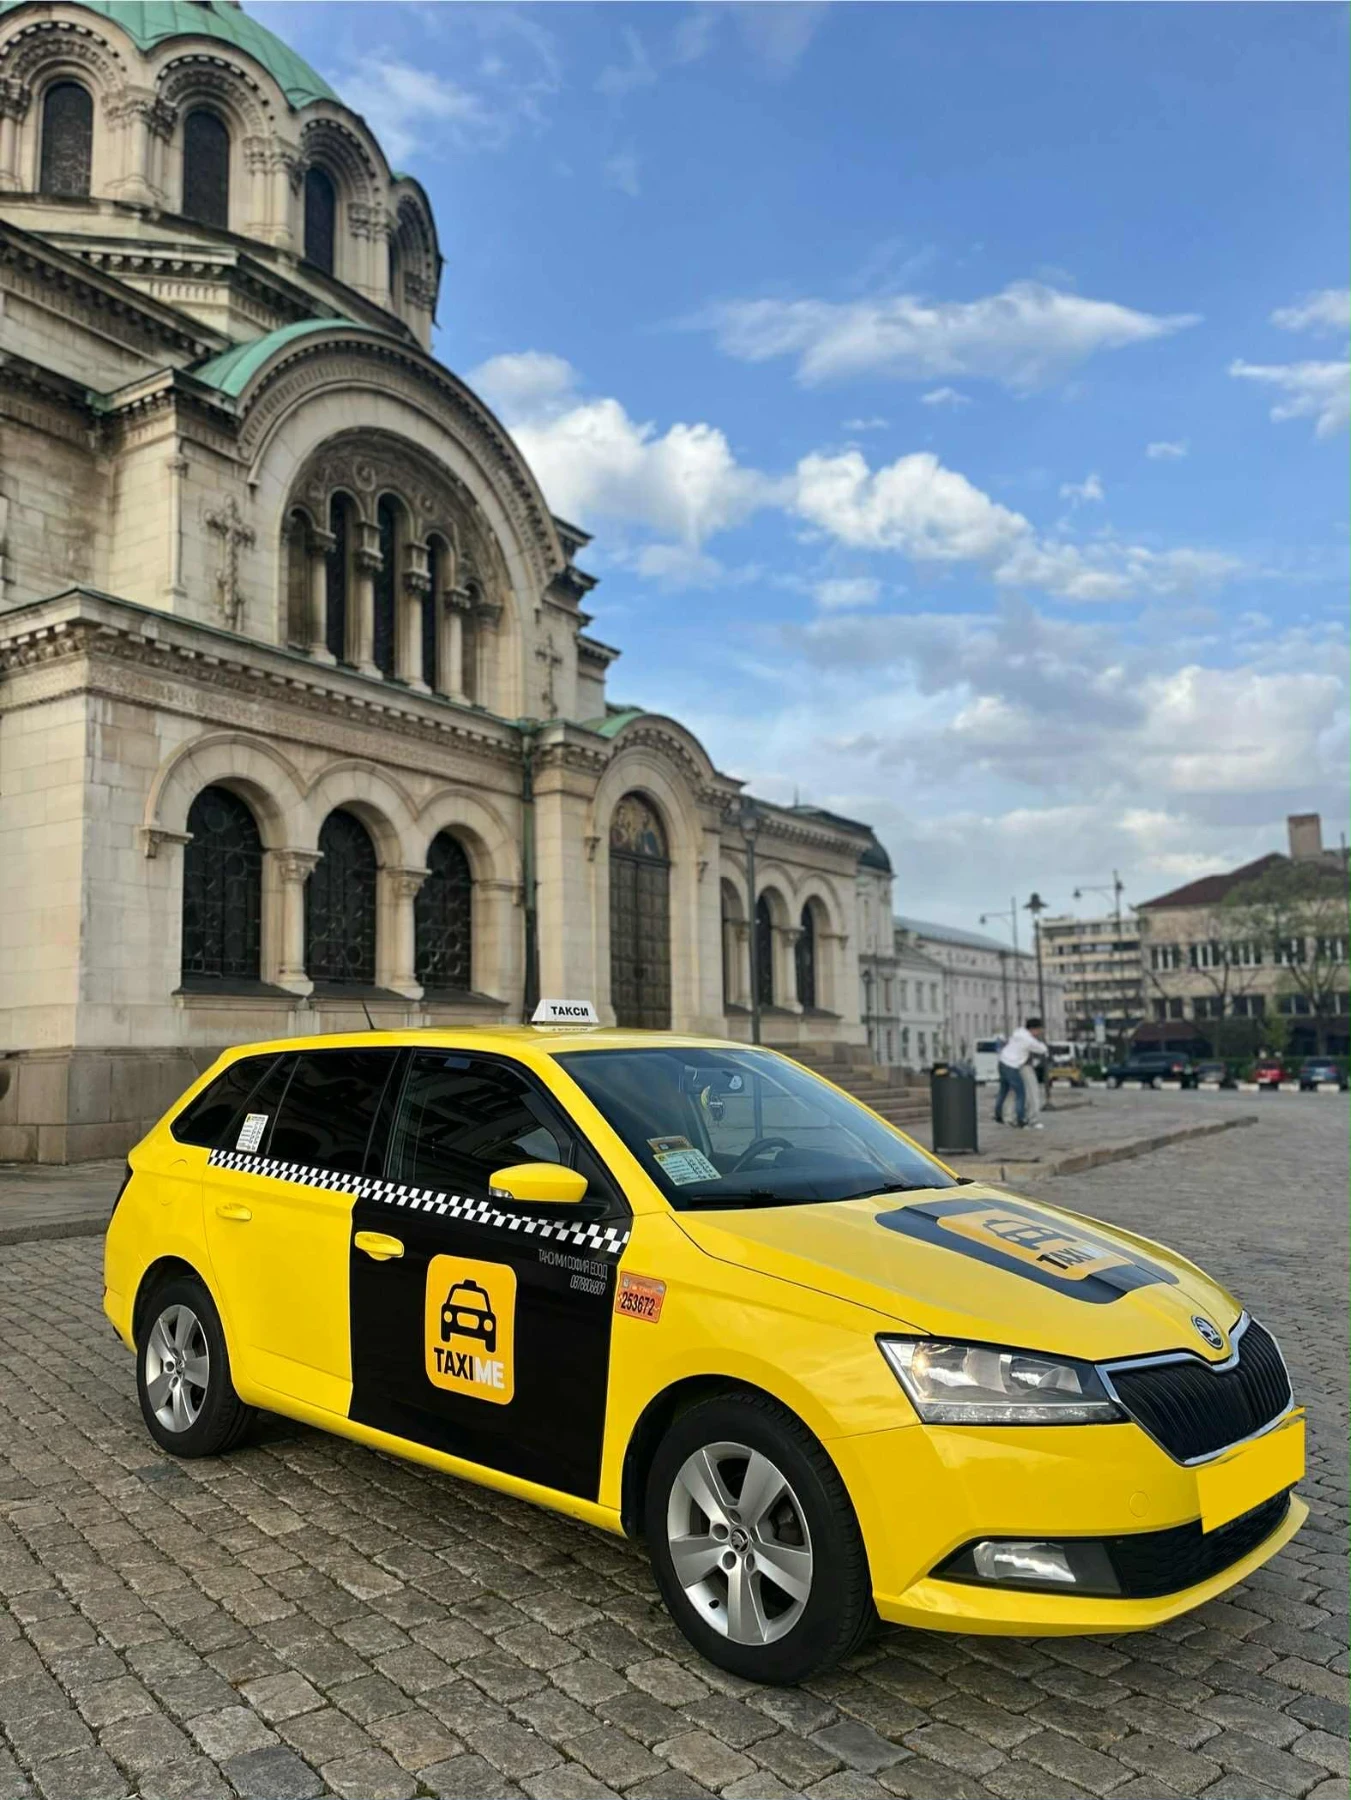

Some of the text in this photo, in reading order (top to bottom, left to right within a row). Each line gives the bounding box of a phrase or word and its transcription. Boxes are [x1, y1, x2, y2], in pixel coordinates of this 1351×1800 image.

[551, 1006, 589, 1016] ТАКСИ
[1036, 1245, 1108, 1270] TAXI
[590, 1261, 608, 1281] ЕООД
[621, 1291, 655, 1316] 253672
[434, 1347, 505, 1389] TAXIME
